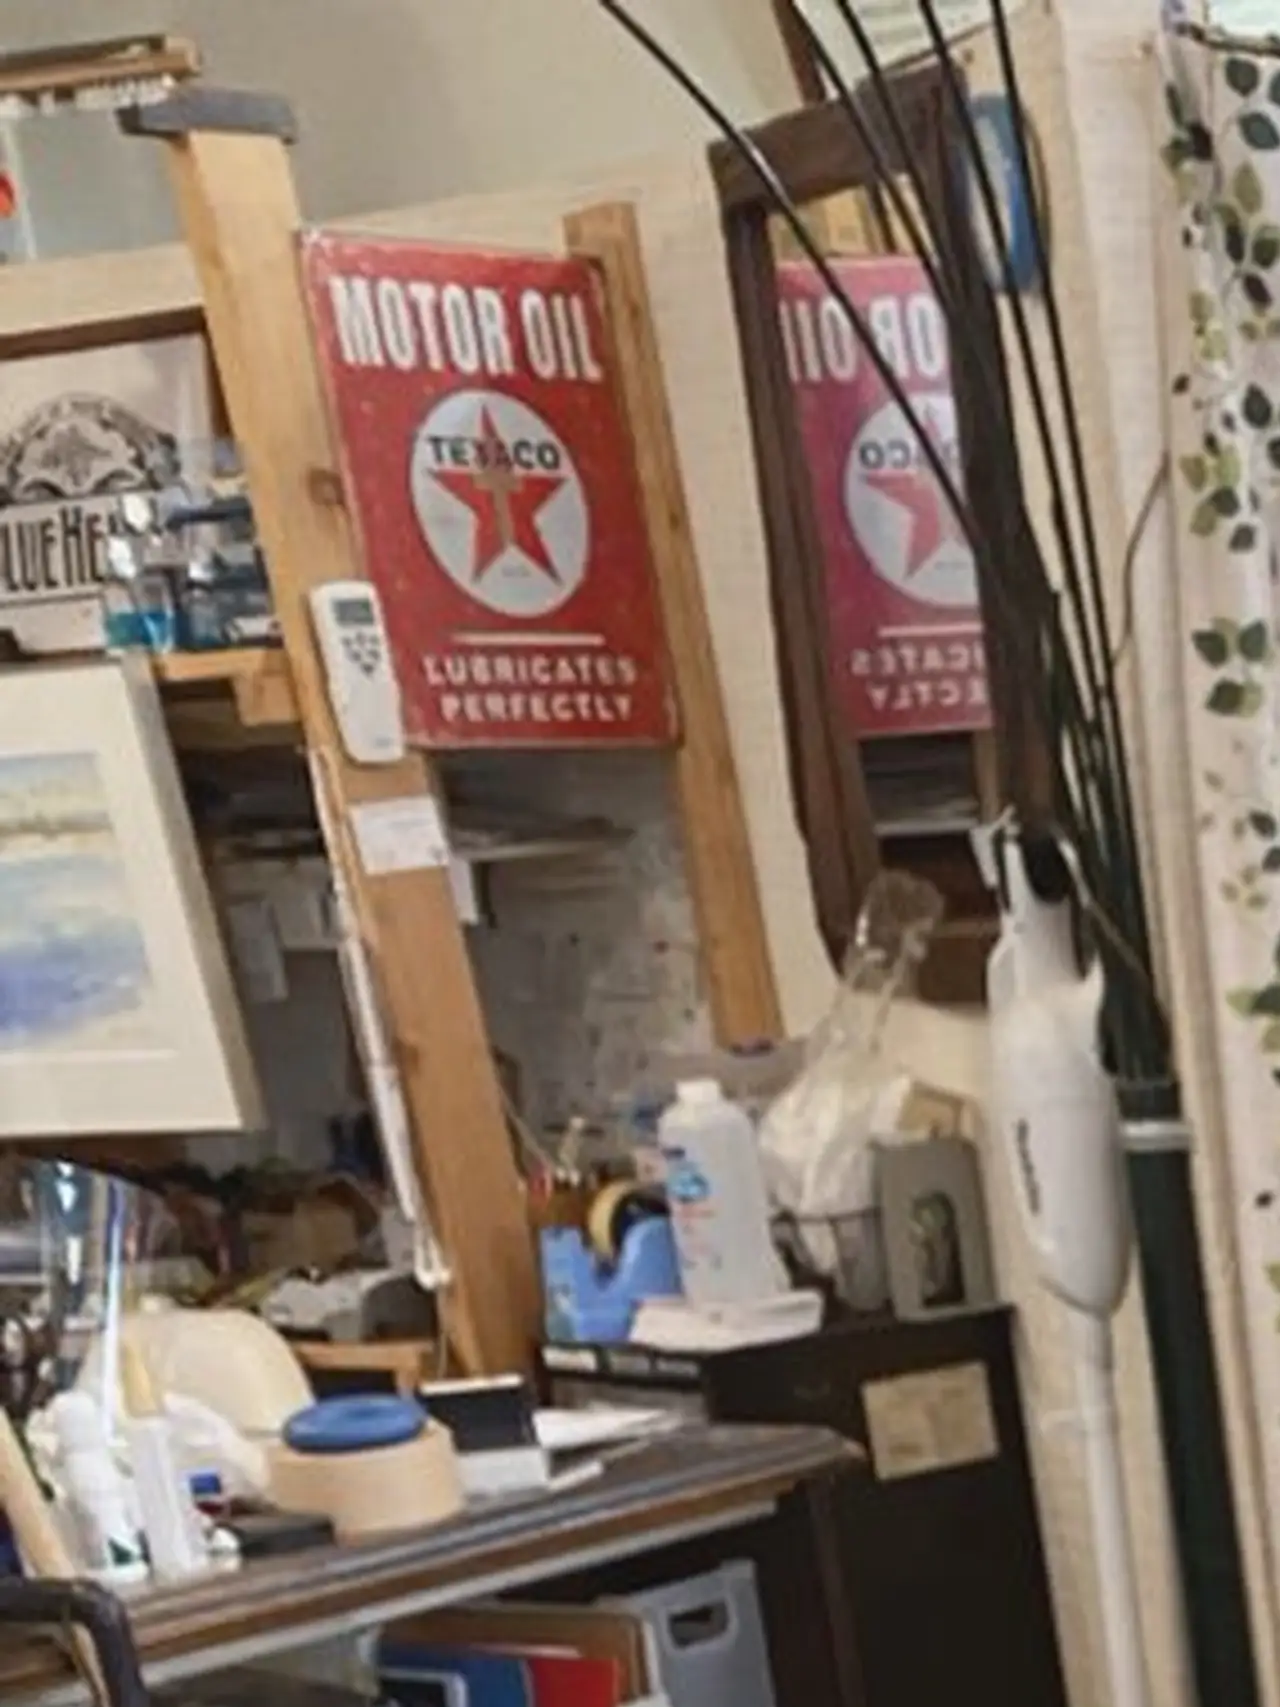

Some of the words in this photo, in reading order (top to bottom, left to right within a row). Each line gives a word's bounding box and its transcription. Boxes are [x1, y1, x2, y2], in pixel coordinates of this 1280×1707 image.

[328, 274, 515, 377] MOTOR
[519, 288, 602, 383] OIL
[427, 434, 563, 471] TEXACO
[421, 652, 637, 687] LUBRICATES
[439, 690, 633, 724] PERFECTLY
